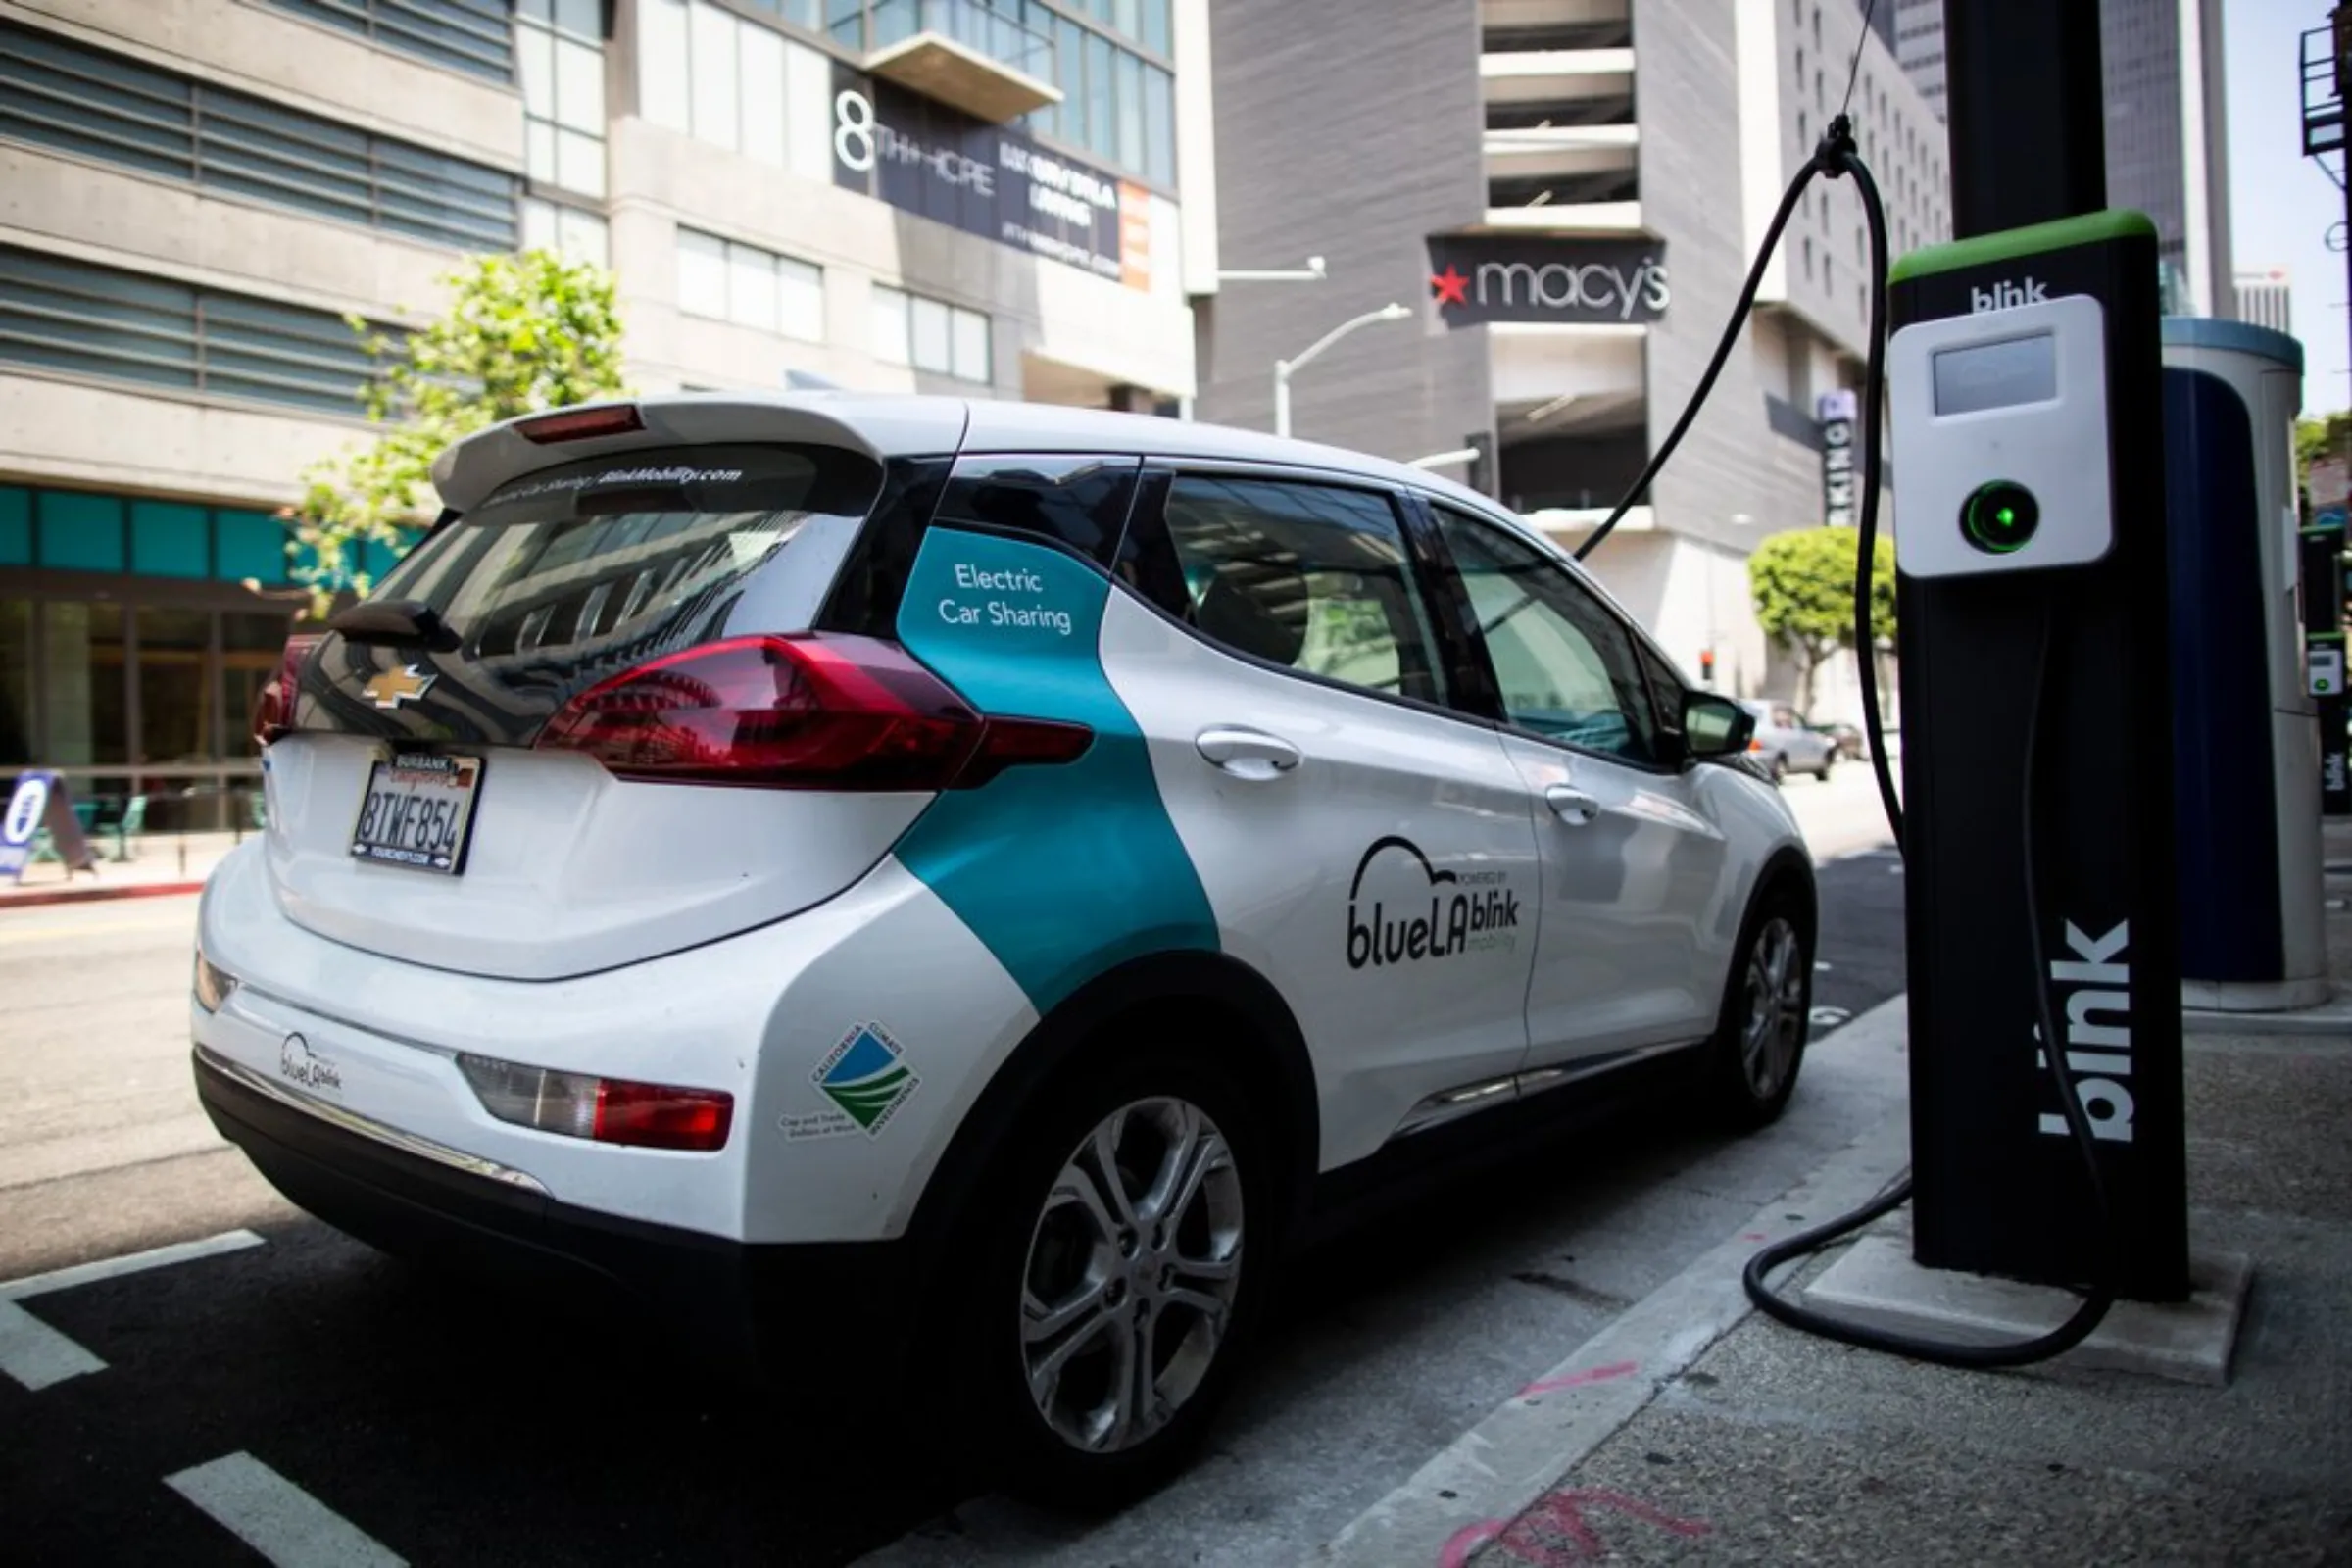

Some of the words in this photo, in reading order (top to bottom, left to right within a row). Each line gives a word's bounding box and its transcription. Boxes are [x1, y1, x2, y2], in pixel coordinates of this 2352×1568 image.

[1476, 256, 1670, 320] macy's
[1971, 276, 2048, 314] blink
[954, 564, 1043, 592] Electric
[938, 599, 981, 623] Car
[988, 601, 1072, 635] Sharing
[1470, 888, 1520, 932] blink
[2033, 917, 2134, 1143] blink
[811, 1023, 863, 1082] CALIFORNIA
